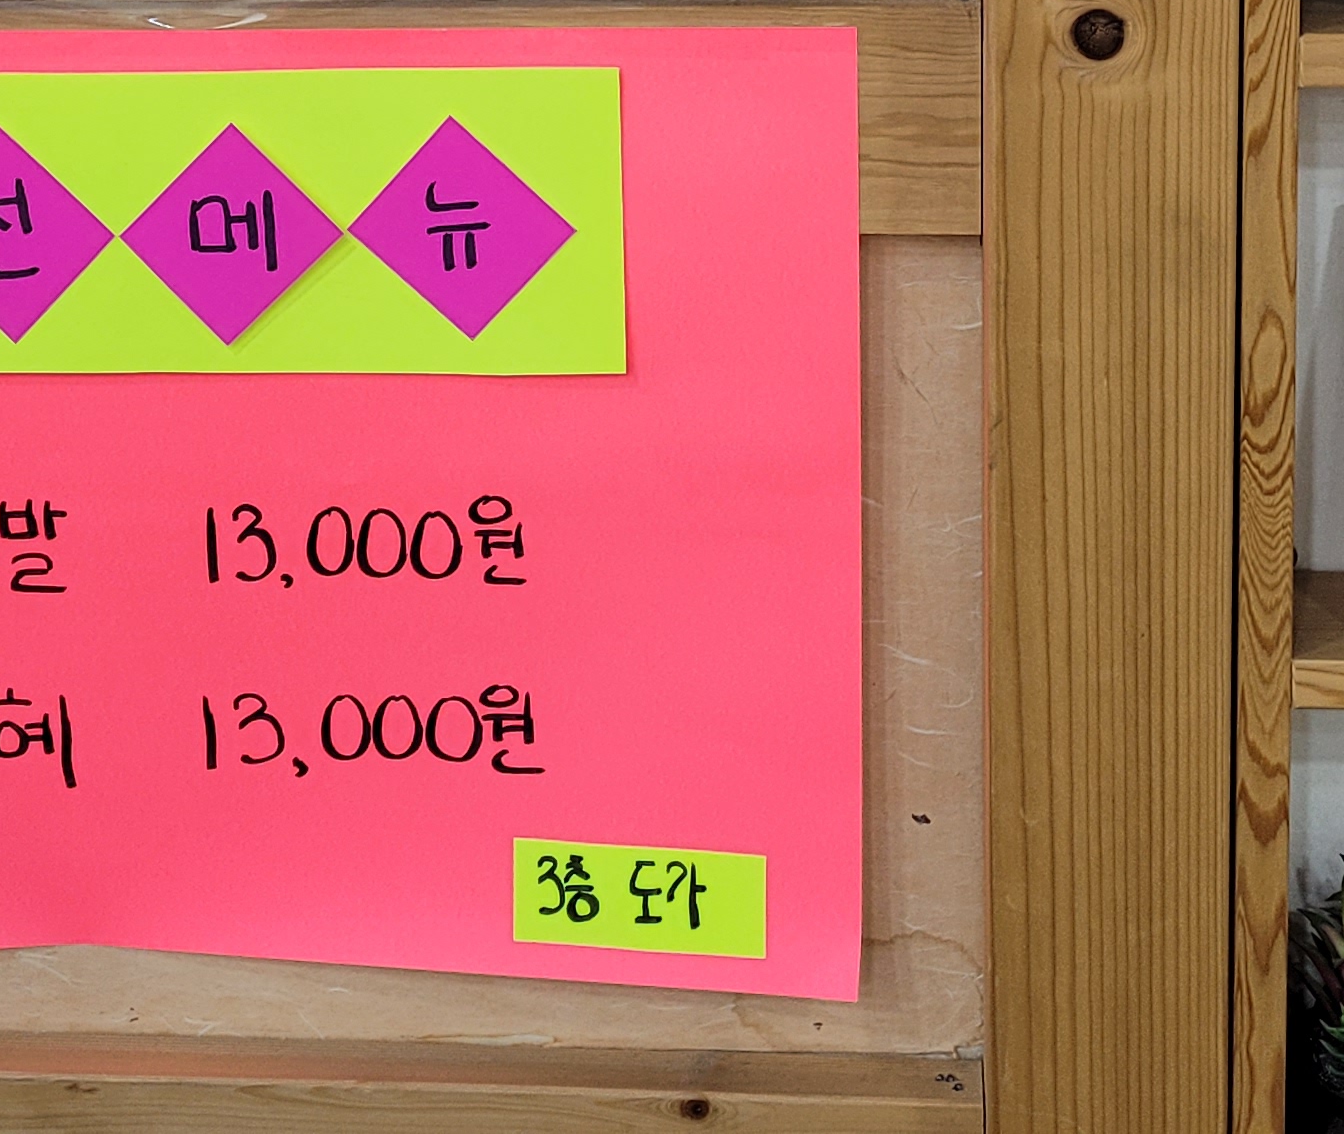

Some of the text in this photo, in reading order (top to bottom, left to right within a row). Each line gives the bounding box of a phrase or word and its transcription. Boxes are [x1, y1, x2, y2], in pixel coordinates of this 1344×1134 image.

[207, 496, 526, 588] 13,000원
[203, 685, 545, 777] 13,000원
[538, 855, 707, 929] 3층 도가
